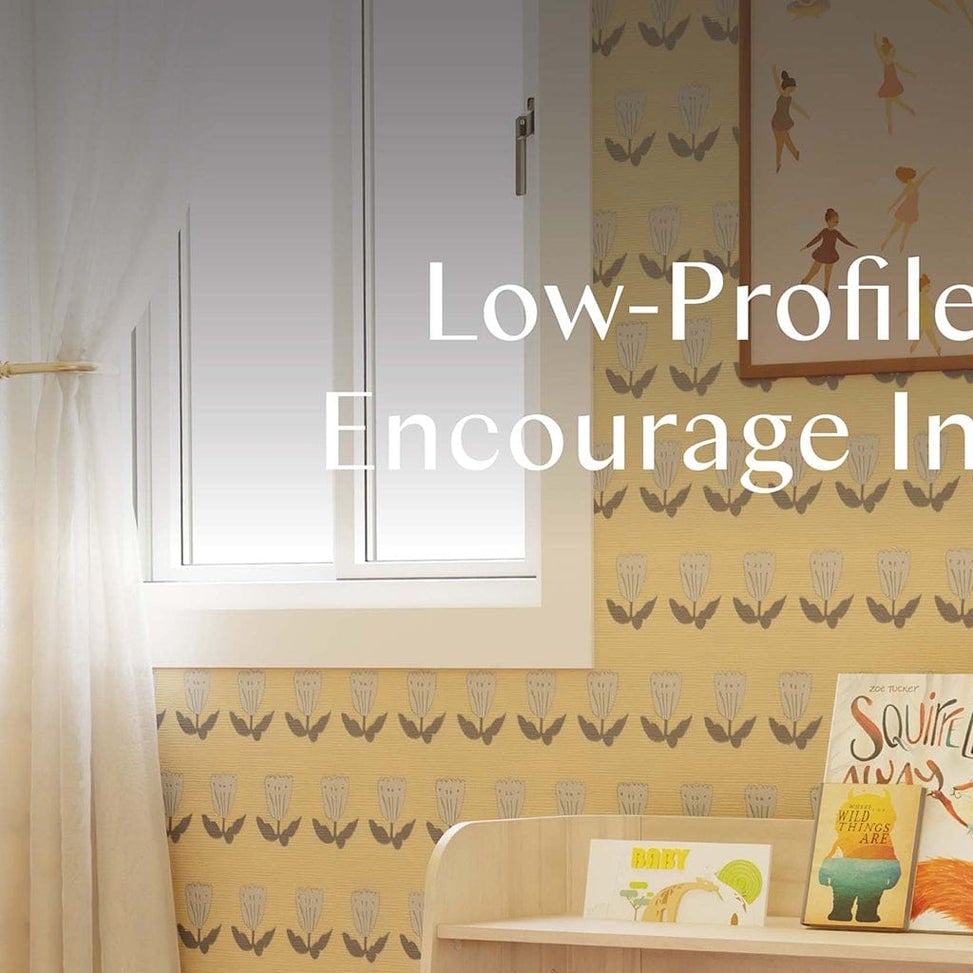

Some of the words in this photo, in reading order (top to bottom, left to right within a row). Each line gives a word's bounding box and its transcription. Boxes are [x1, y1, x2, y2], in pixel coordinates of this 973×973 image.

[838, 810, 870, 822] WILD
[839, 822, 891, 833] THINGS
[859, 833, 890, 845] ARE
[631, 847, 690, 871] BABY
